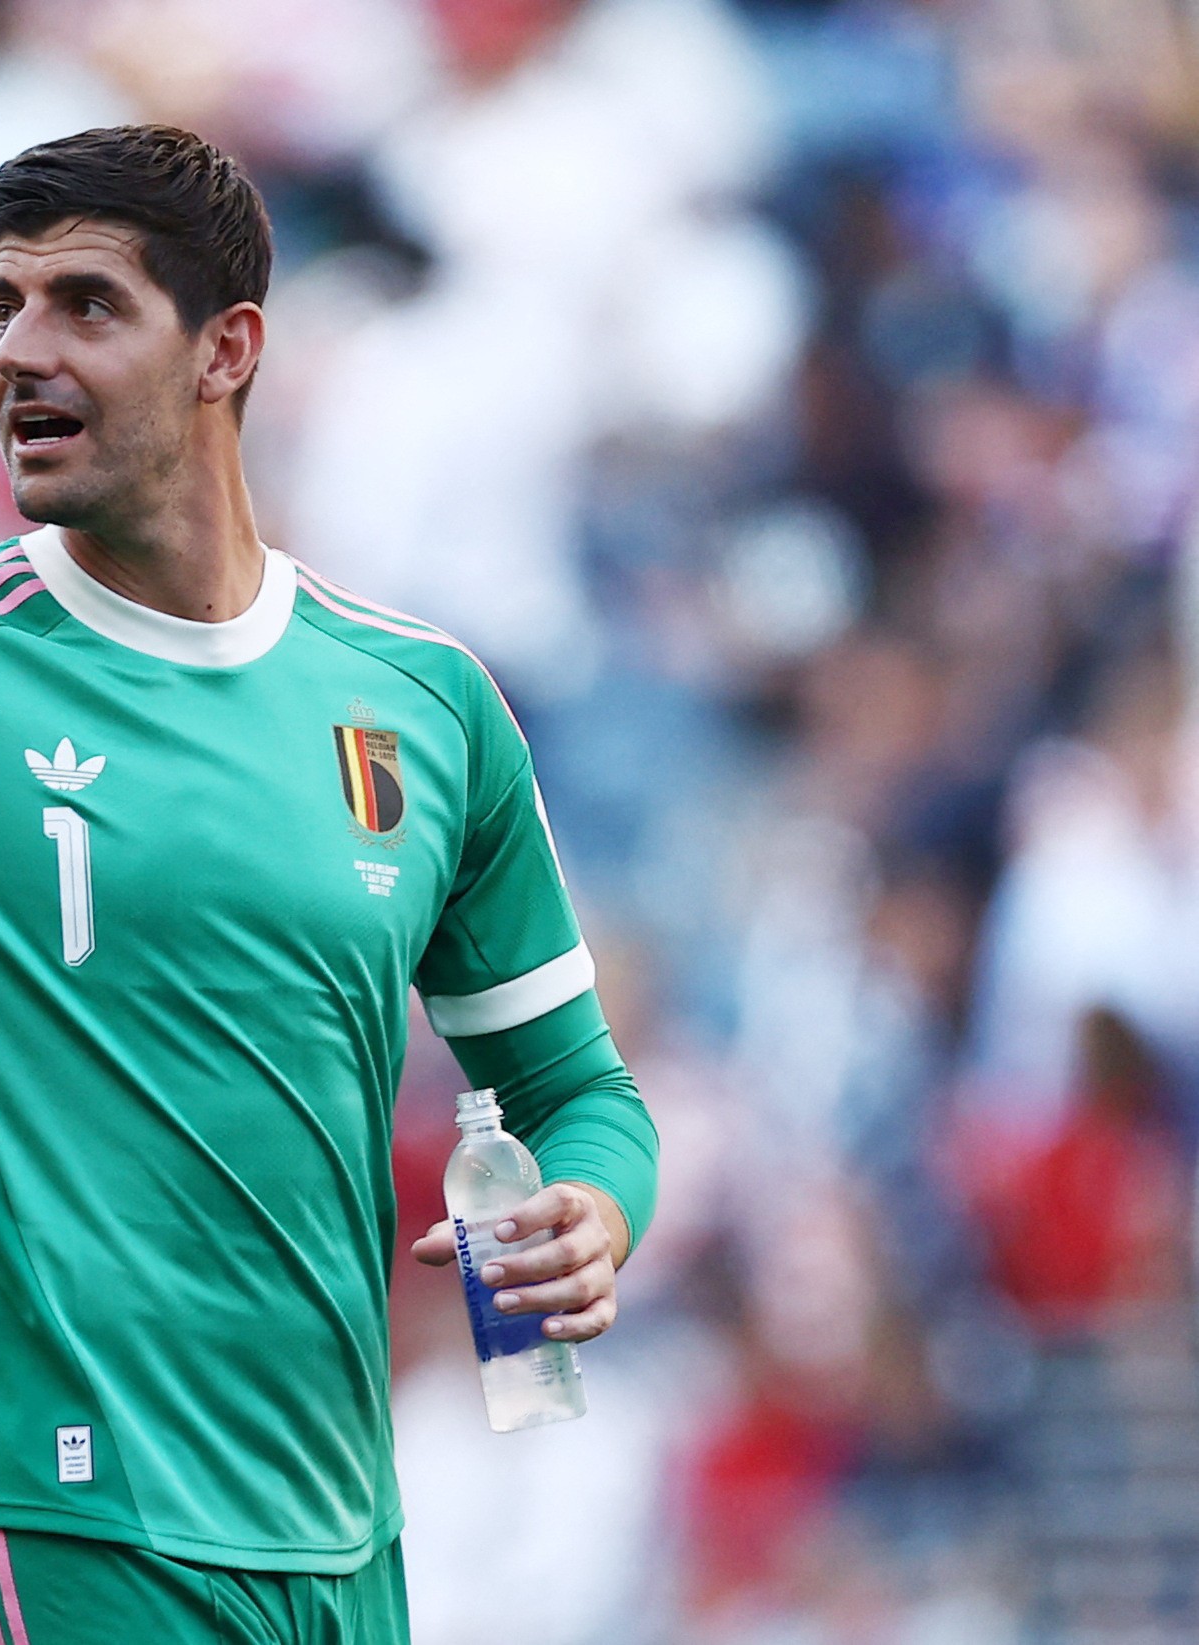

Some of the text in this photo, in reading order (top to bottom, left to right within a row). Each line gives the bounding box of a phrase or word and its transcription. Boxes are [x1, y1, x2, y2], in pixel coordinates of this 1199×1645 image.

[365, 731, 387, 742] ROYAL
[365, 740, 397, 752] BELGIAN
[43, 806, 96, 967] 1
